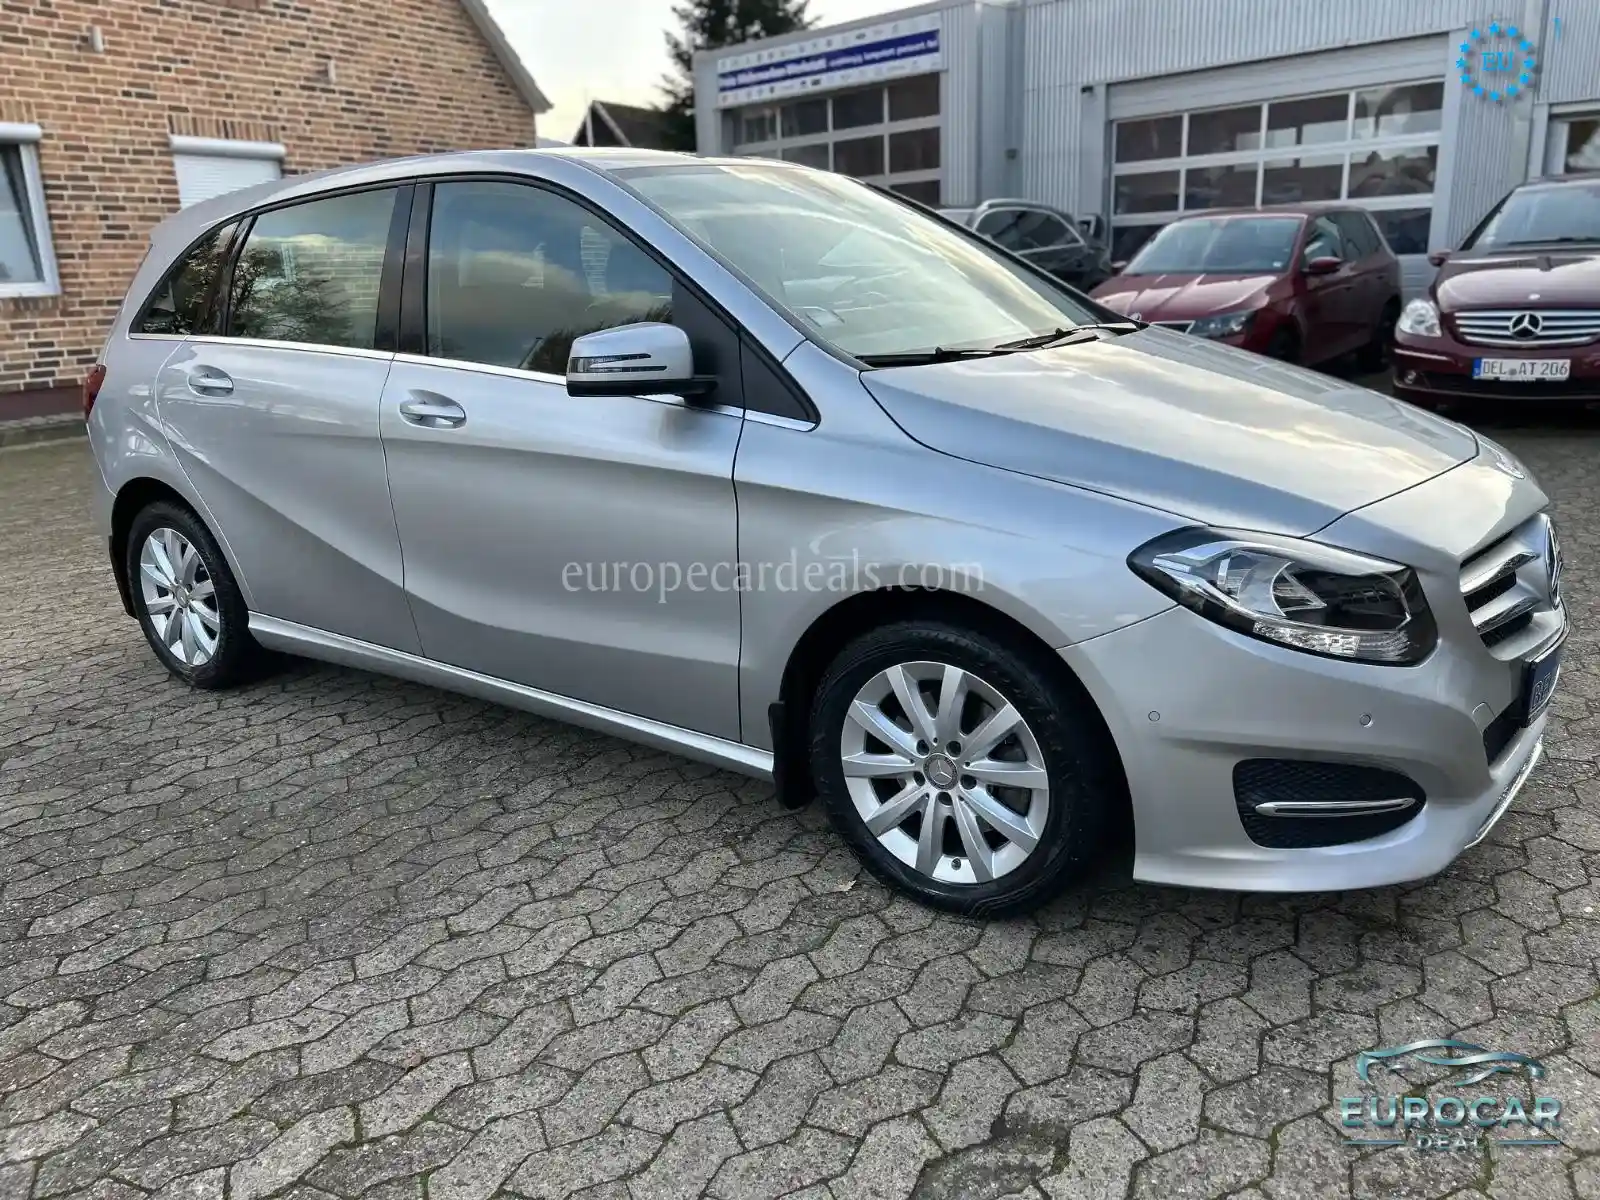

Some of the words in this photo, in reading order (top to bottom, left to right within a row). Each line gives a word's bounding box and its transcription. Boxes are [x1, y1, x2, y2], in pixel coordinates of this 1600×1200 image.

[1482, 360, 1507, 375] DEL
[1519, 361, 1537, 375] AT
[1540, 361, 1569, 376] 206
